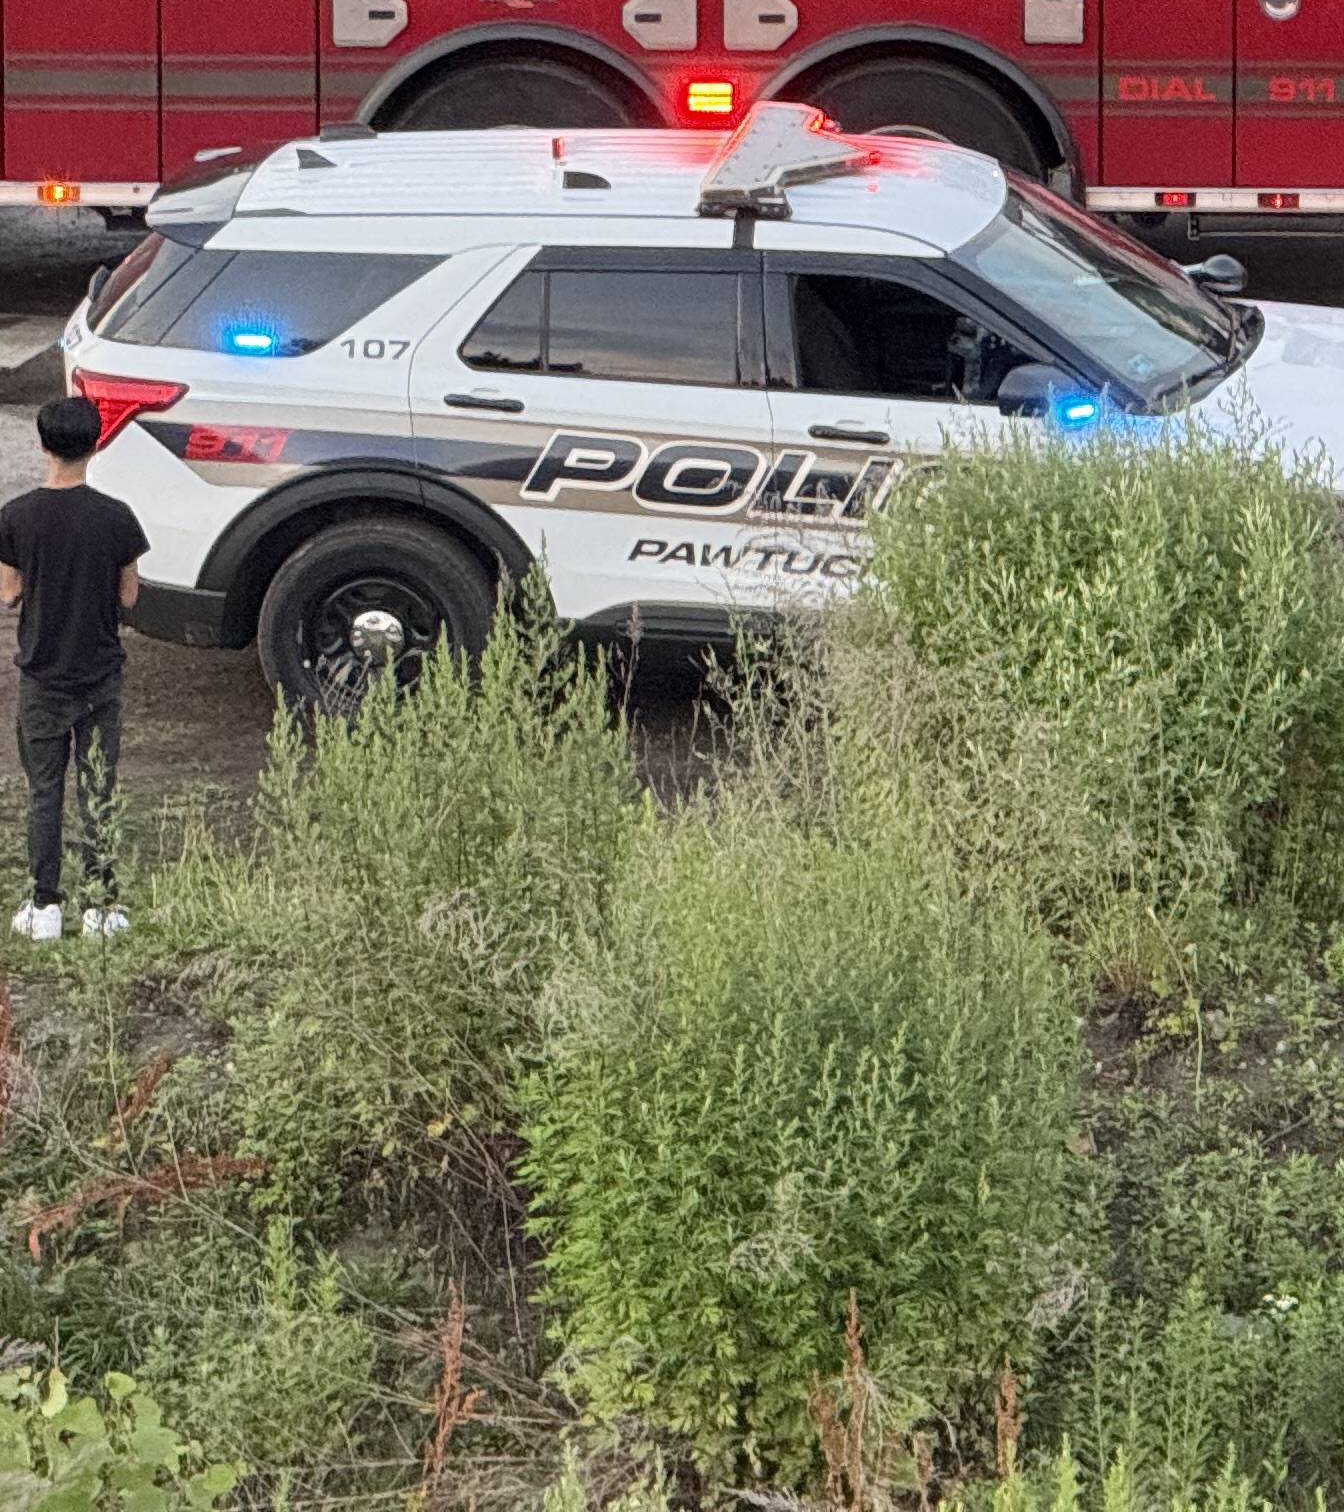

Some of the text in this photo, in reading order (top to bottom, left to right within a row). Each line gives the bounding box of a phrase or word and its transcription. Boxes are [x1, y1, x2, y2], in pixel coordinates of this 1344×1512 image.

[1119, 76, 1335, 101] DIAL 911
[341, 339, 410, 360] 107
